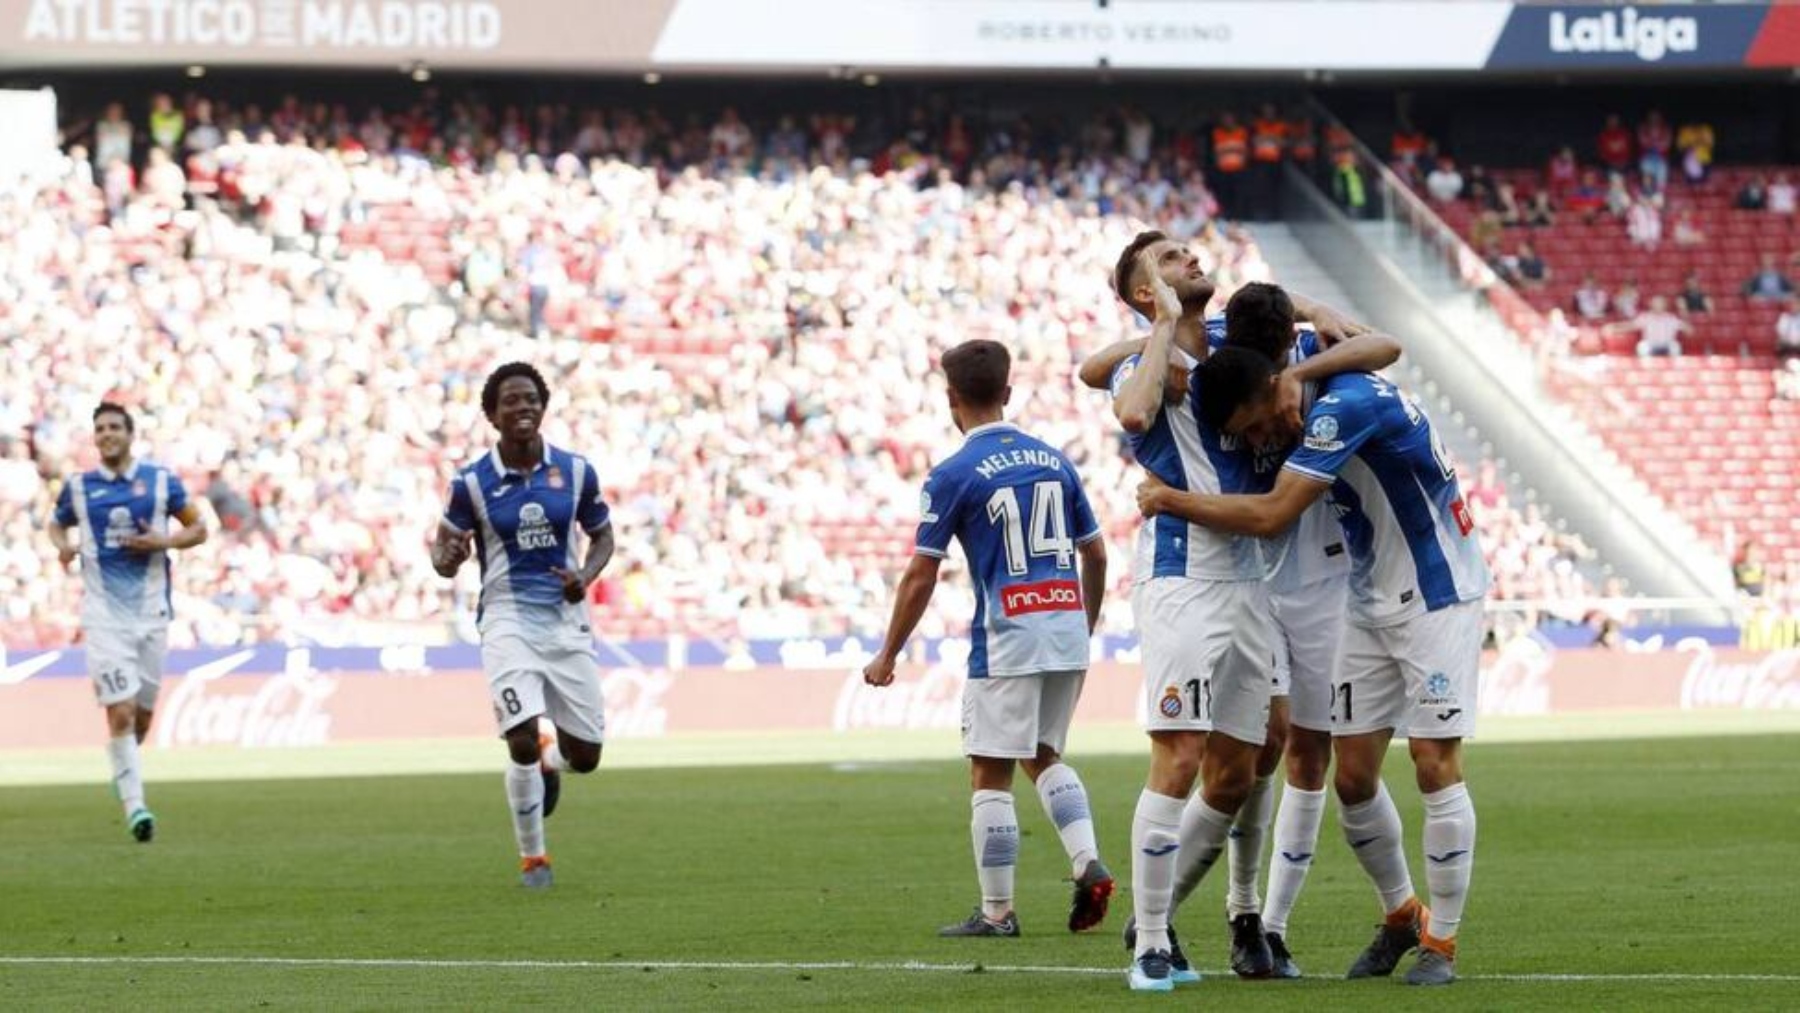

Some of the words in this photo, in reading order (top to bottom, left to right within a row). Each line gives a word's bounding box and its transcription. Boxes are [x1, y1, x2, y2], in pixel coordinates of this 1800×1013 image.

[302, 0, 501, 48] MADRID
[978, 20, 1115, 42] ROBERTO
[1123, 22, 1233, 43] VERINO
[1549, 6, 1698, 61] LaLiga
[975, 449, 1061, 480] MELENDO
[986, 481, 1074, 577] 14
[101, 669, 128, 694] 16
[501, 687, 523, 716] 8
